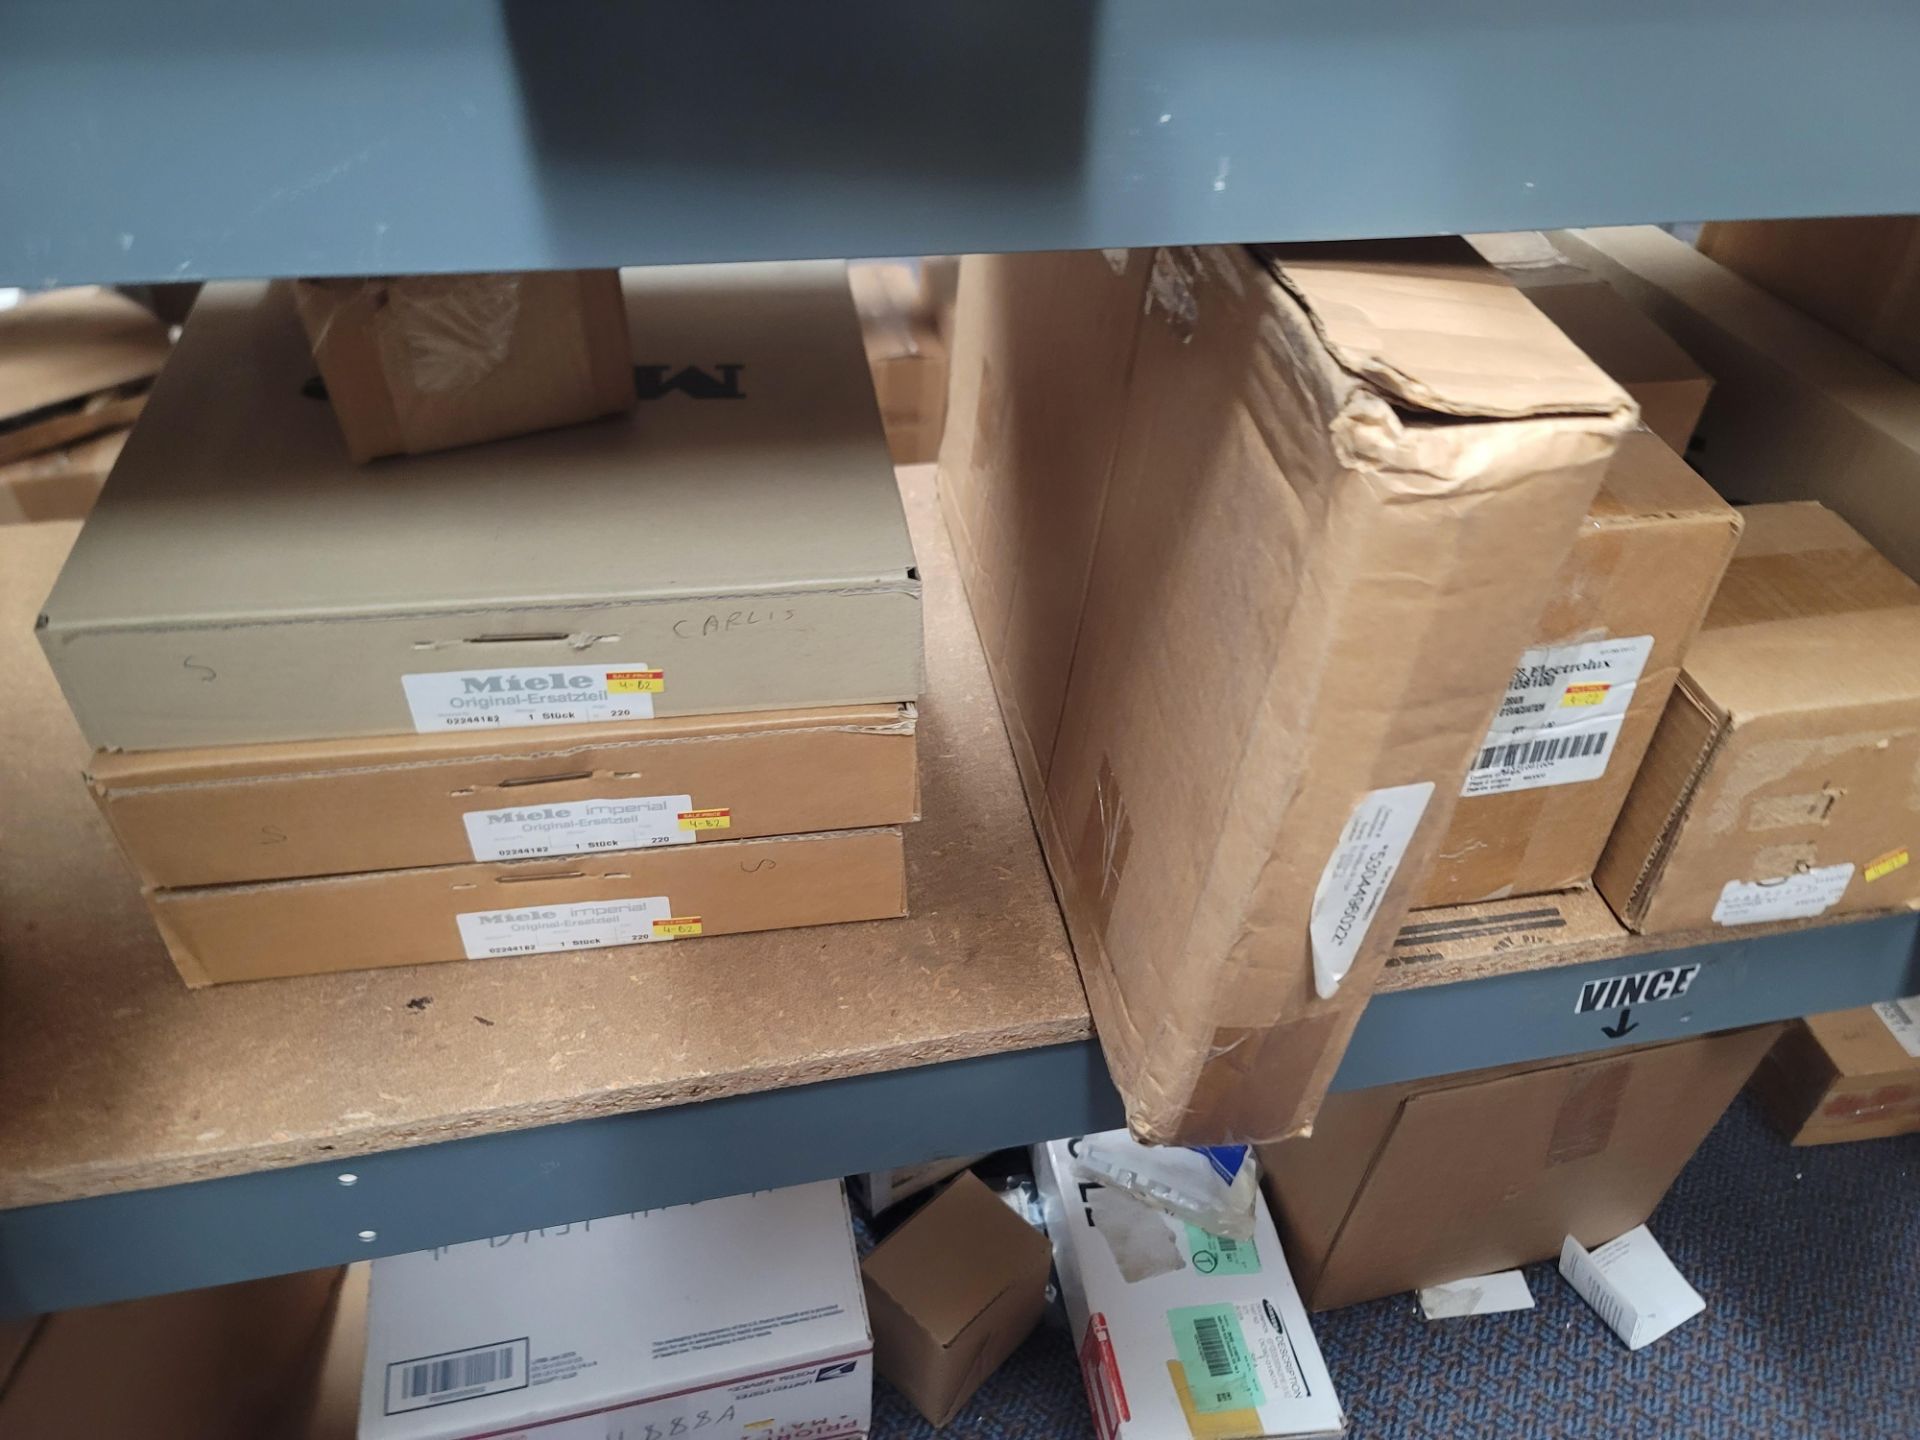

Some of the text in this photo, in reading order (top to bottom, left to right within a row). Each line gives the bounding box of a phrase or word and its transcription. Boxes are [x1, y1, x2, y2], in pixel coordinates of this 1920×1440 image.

[460, 673, 594, 695] Miele
[450, 690, 608, 709] Original-Ersatzteil
[610, 708, 631, 718] 220
[487, 801, 668, 826] Miele imperial
[522, 814, 639, 834] Original-Ersatzteil
[651, 836, 670, 844] 220
[479, 902, 648, 926] Miele imperial
[511, 915, 620, 932] Original-Ersatzteil
[631, 934, 649, 942] 220
[1578, 966, 1698, 1014] VINCE
[764, 1415, 828, 1435] MAIL
